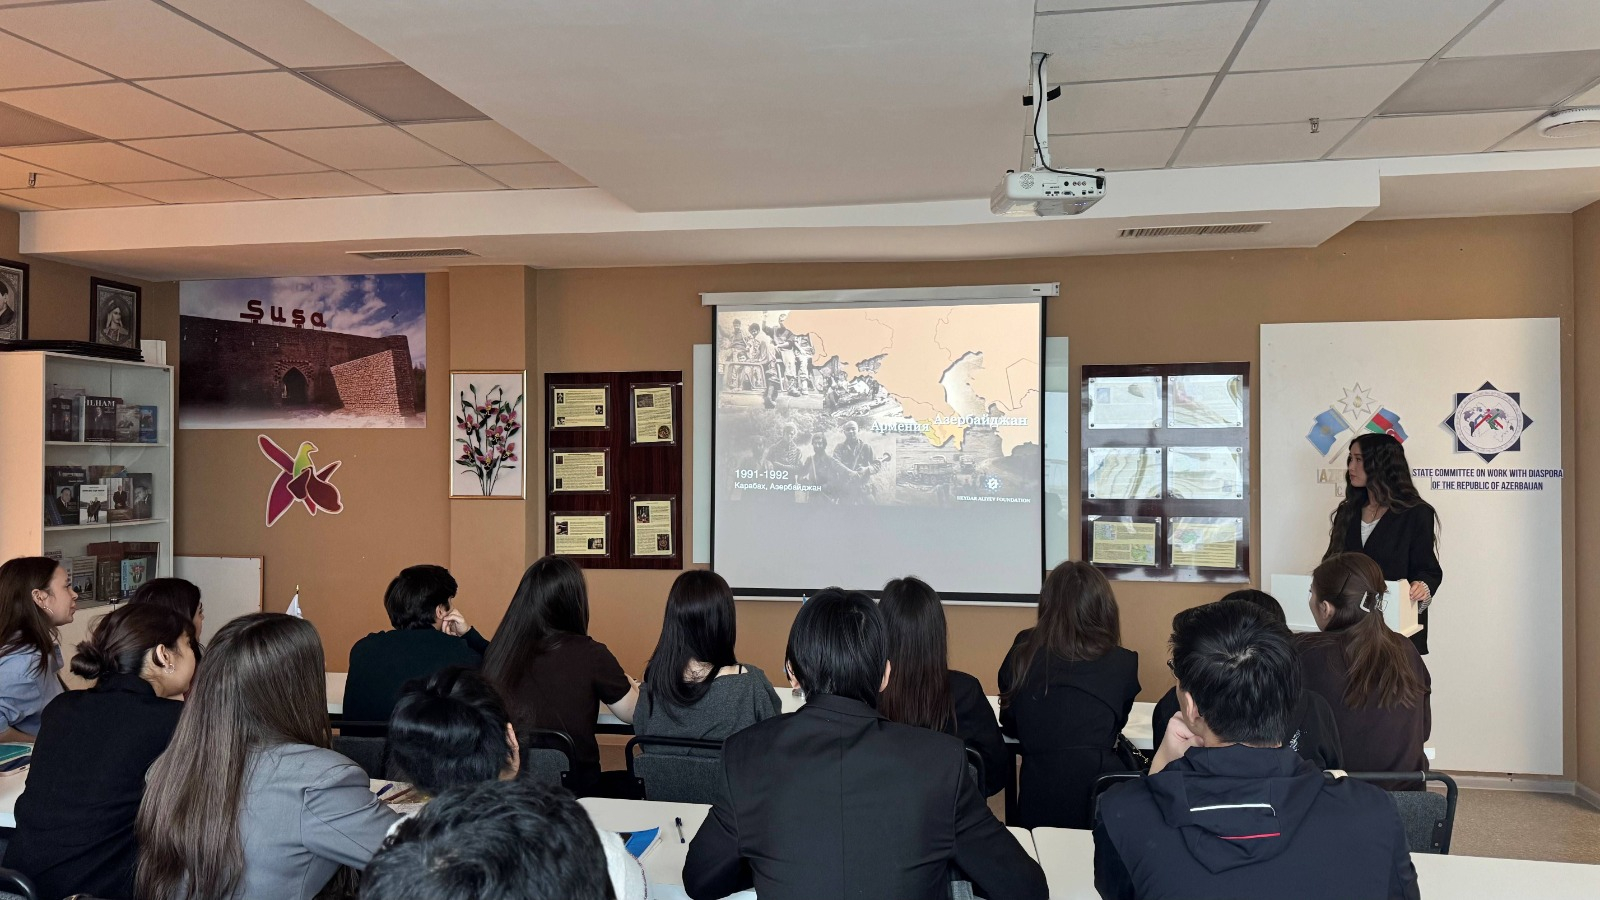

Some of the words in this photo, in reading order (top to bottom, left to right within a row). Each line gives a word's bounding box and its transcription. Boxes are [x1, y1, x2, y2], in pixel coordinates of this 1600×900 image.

[86, 399, 115, 407] ILHAM
[933, 413, 1029, 428] Азербайджан
[870, 420, 931, 434] Армения
[734, 469, 789, 480] 1991-1992
[1412, 468, 1433, 477] STATE
[1434, 468, 1475, 477] COMMITTEE
[1476, 468, 1486, 477] ON
[1487, 468, 1508, 478] WORK
[1509, 469, 1527, 478] WITH
[1528, 469, 1563, 478] DIASPORA
[734, 481, 768, 491] Карабах,
[769, 482, 822, 492] Азербайджан
[1432, 480, 1441, 490] OF
[1442, 480, 1455, 490] THE
[1456, 481, 1490, 490] REPUBLIC
[1490, 481, 1500, 490] OF
[1501, 481, 1544, 491] AZERBAIJAN
